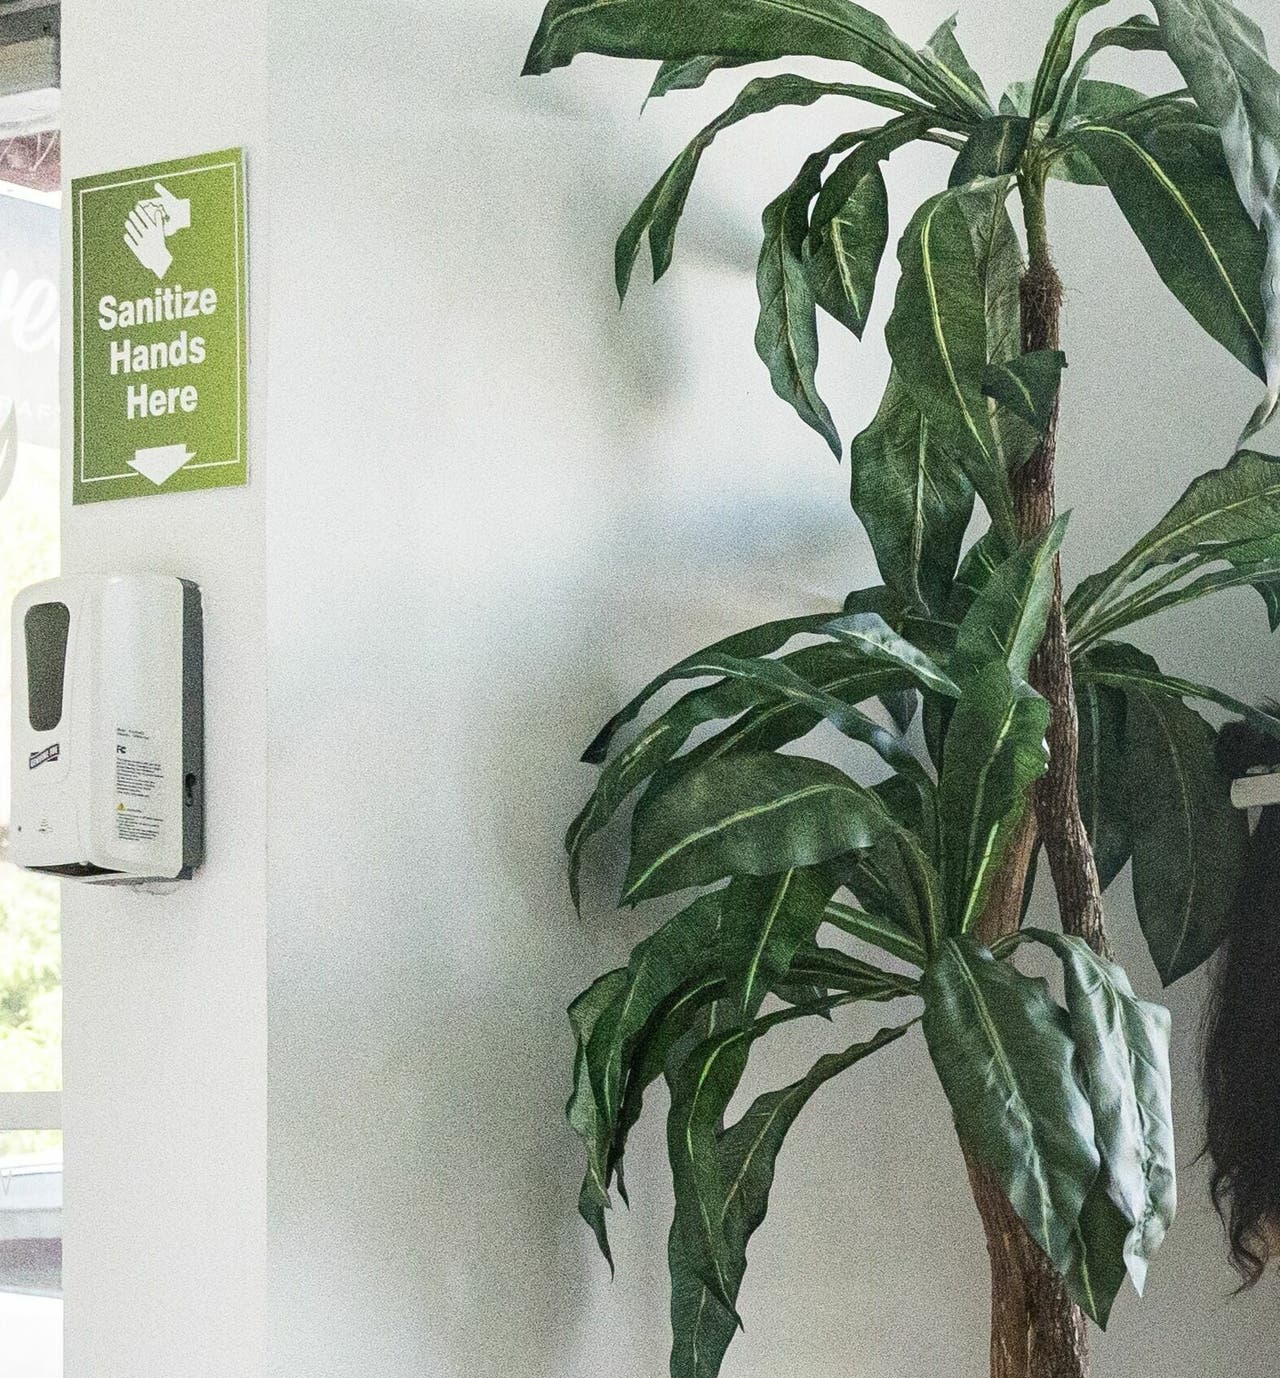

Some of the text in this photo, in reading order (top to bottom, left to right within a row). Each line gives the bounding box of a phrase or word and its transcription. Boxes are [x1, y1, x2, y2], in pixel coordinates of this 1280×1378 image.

[98, 283, 218, 333] Sanitize
[109, 331, 206, 375] Hands
[126, 383, 199, 420] Here
